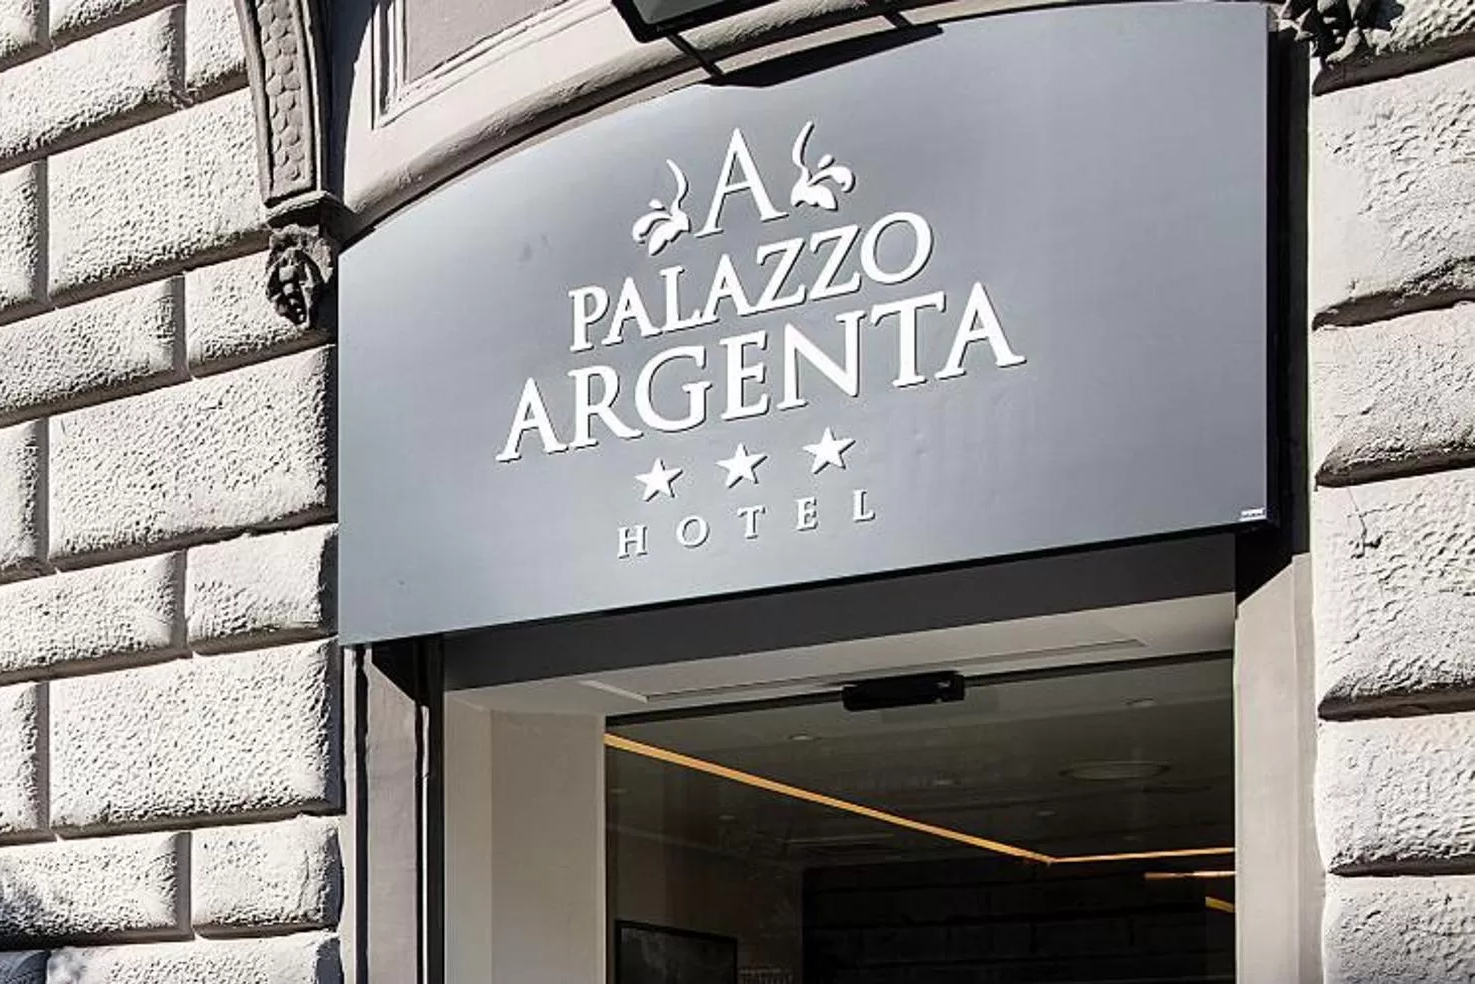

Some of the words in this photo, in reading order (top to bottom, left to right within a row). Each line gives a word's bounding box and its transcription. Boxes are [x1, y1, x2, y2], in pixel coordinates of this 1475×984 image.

[694, 128, 787, 238] A
[568, 211, 933, 352] PALAZZO
[495, 281, 1026, 462] ARGENTA
[617, 489, 875, 558] HOTEL
